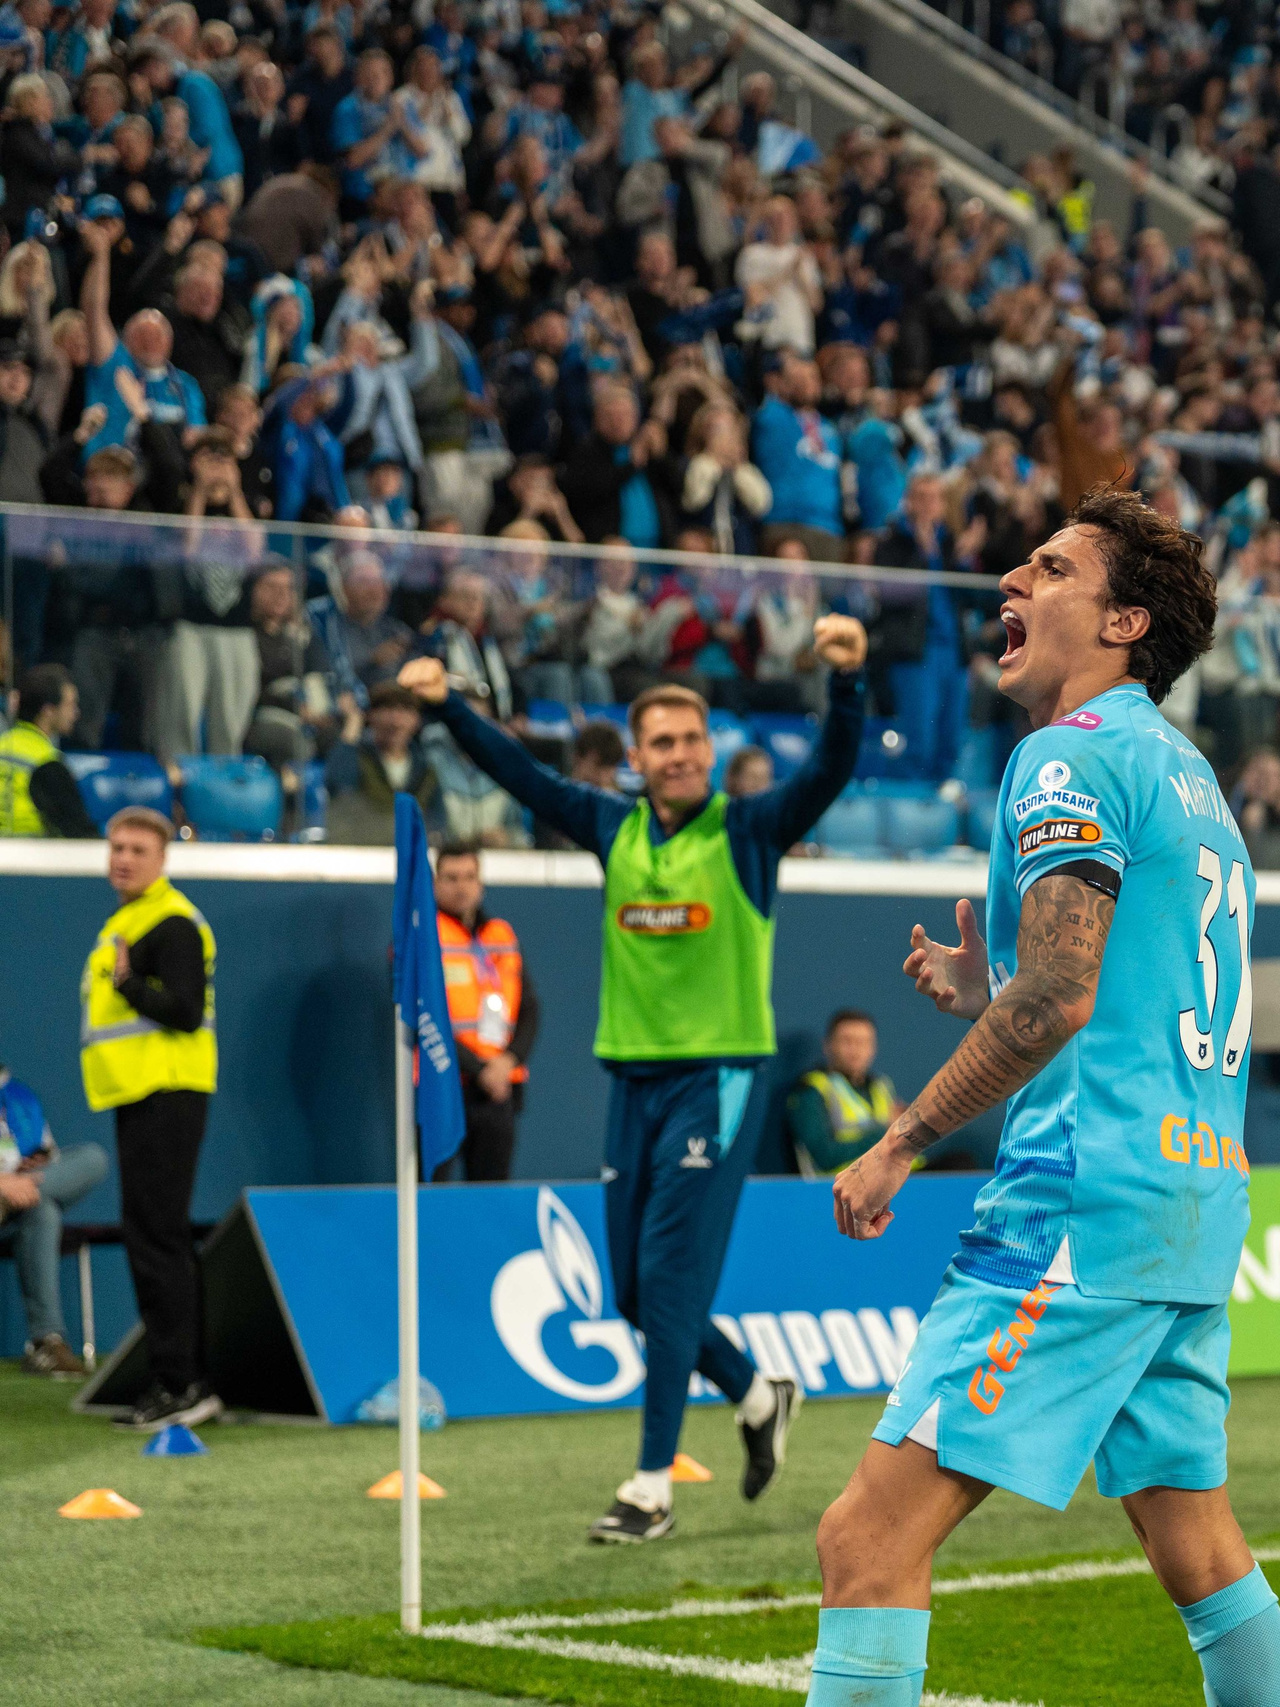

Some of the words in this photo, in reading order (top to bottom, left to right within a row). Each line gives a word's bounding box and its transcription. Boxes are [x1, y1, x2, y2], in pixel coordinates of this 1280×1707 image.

[1015, 790, 1096, 817] ГАЗПРОМБАНК
[1022, 823, 1079, 851] WINLINE
[1178, 842, 1253, 1078] 31
